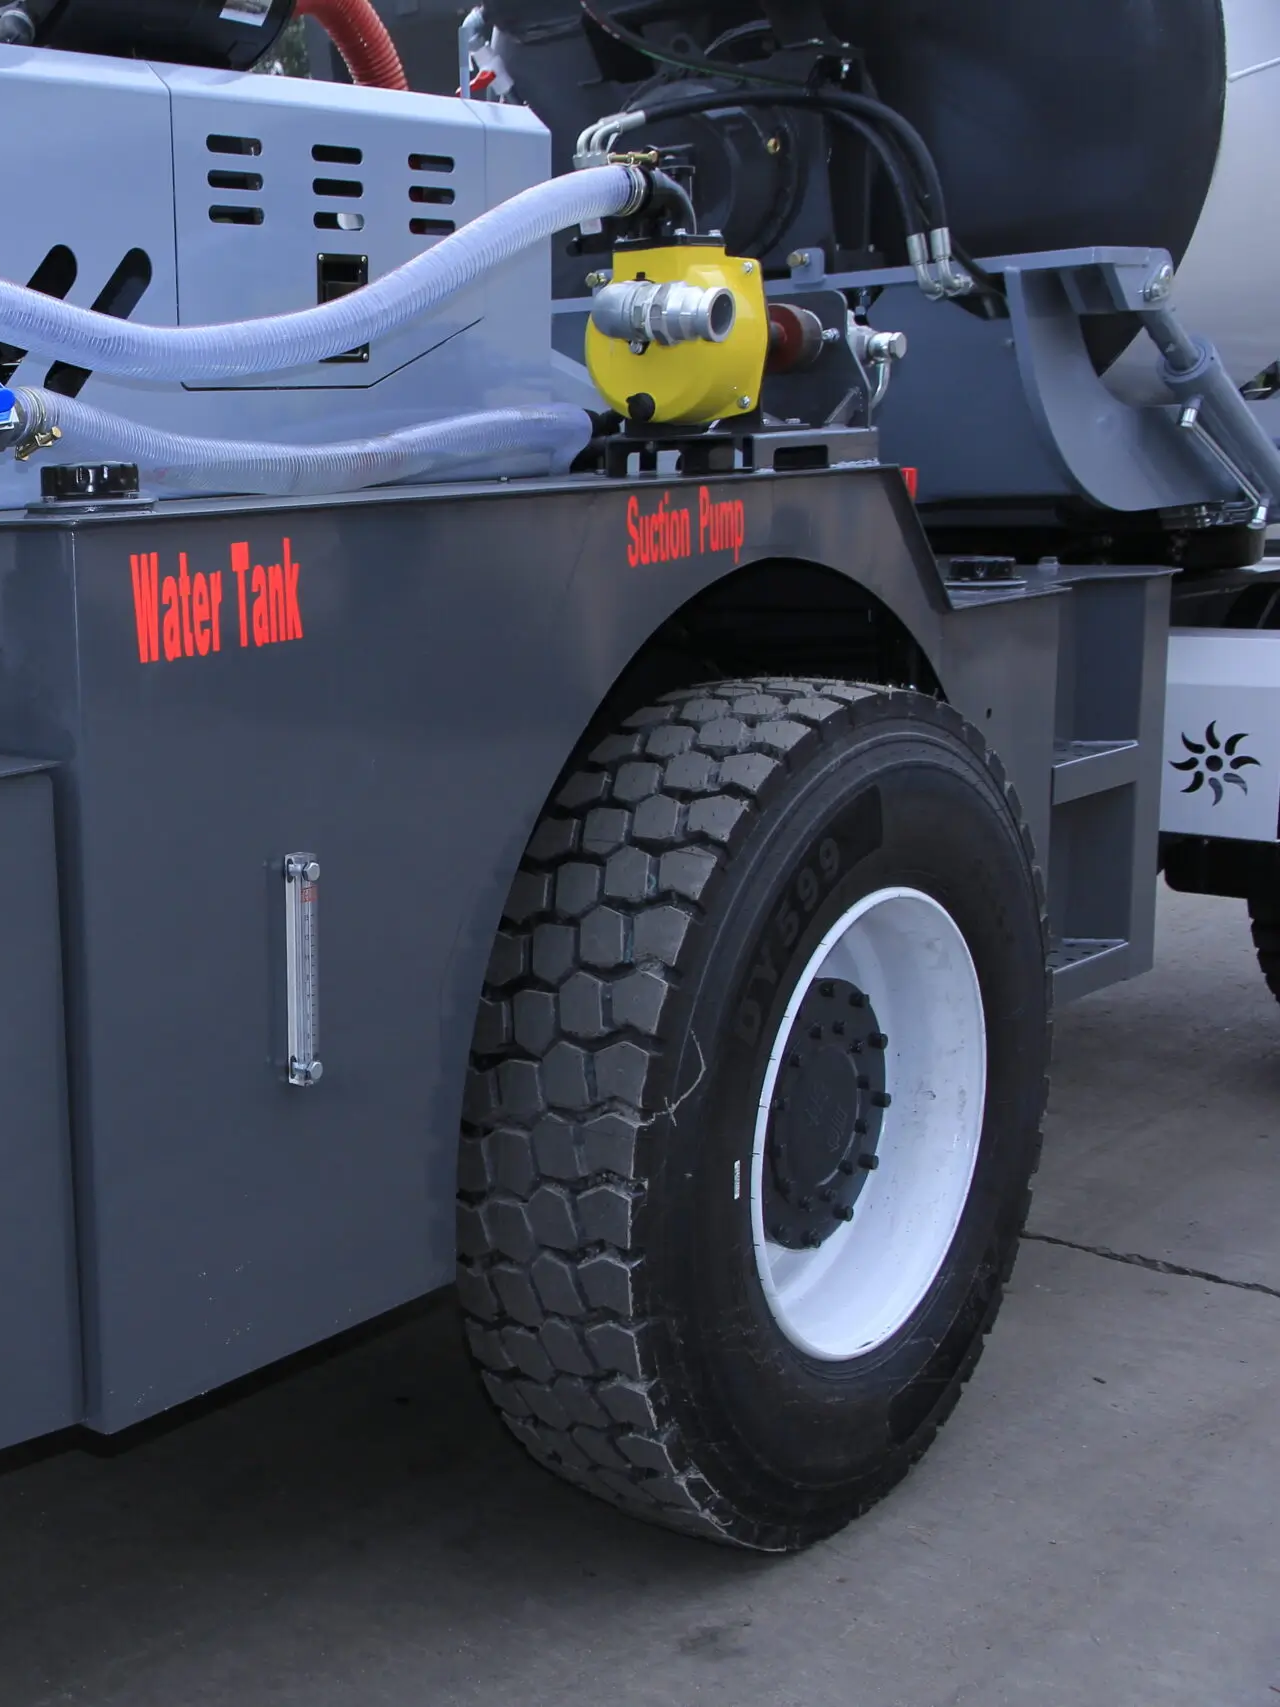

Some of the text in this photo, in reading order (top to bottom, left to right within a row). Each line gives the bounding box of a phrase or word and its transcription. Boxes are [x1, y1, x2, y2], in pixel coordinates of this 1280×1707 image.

[627, 486, 745, 568] Suction Pump
[129, 537, 304, 664] Water Tank
